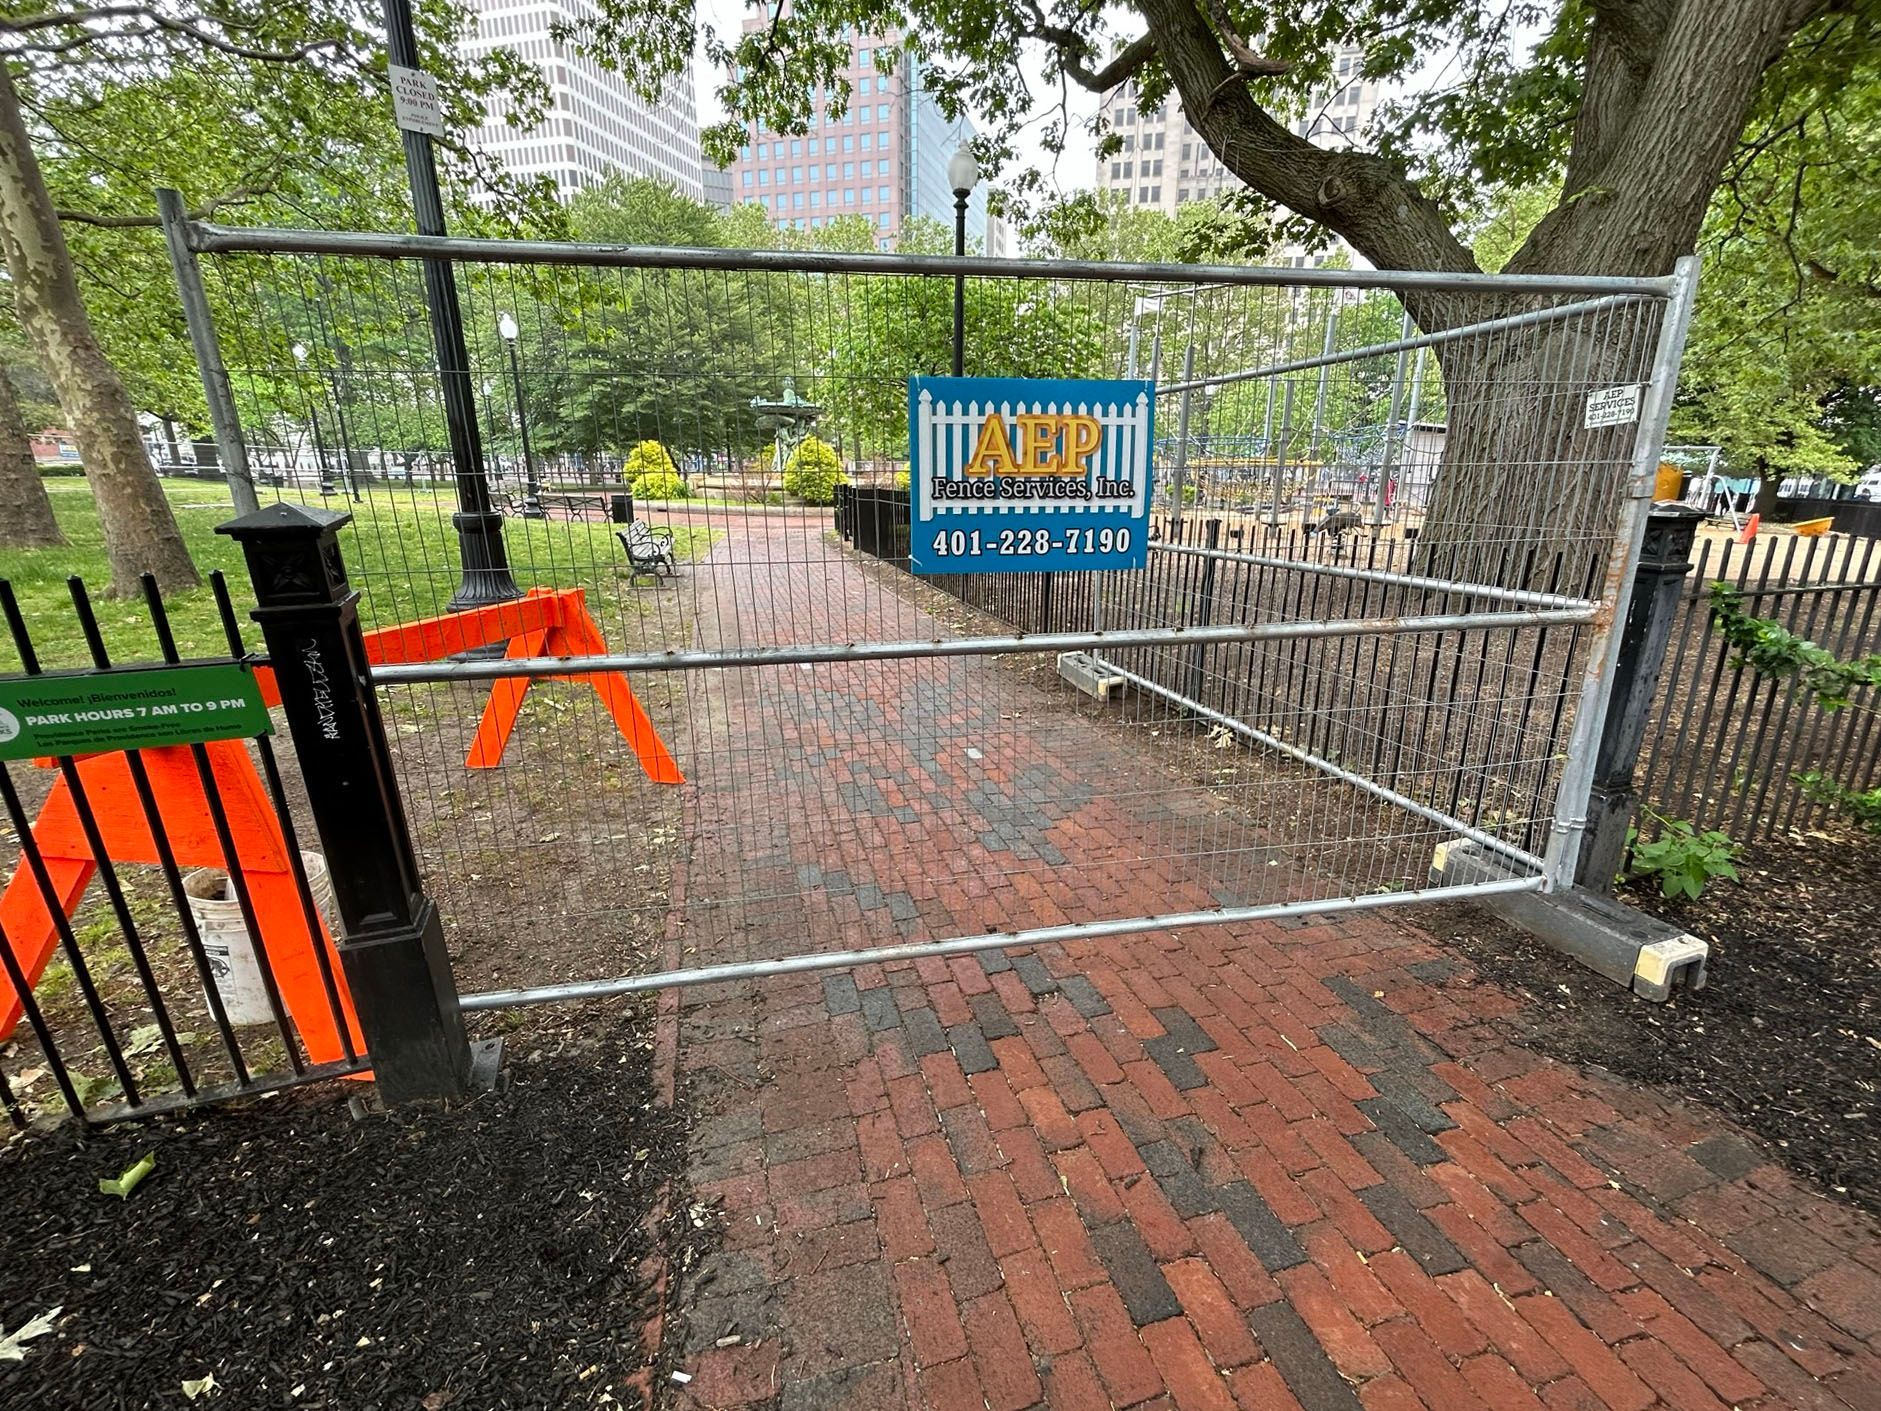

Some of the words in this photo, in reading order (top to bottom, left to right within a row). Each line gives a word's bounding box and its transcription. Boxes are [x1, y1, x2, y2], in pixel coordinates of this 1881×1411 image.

[400, 76, 427, 89] PARK
[396, 85, 435, 101] CLOSED
[400, 96, 418, 107] 9:00
[420, 100, 434, 110] PM
[1603, 389, 1624, 400] AEP
[1589, 397, 1635, 412] SERVICES
[964, 412, 1103, 477] AEP
[932, 477, 995, 499] Fence
[999, 476, 1093, 500] Services,
[1096, 477, 1136, 498] Inc.
[933, 527, 1132, 557] 401-228-7190
[17, 695, 85, 708] Welcome!
[86, 688, 177, 705] ¡Bienvenidos!
[25, 713, 73, 726] PARK
[74, 708, 135, 722] HOURS
[136, 707, 147, 717] 7
[152, 704, 178, 716] AM
[180, 702, 203, 713] TO
[205, 701, 217, 711] 9
[220, 698, 246, 709] PM
